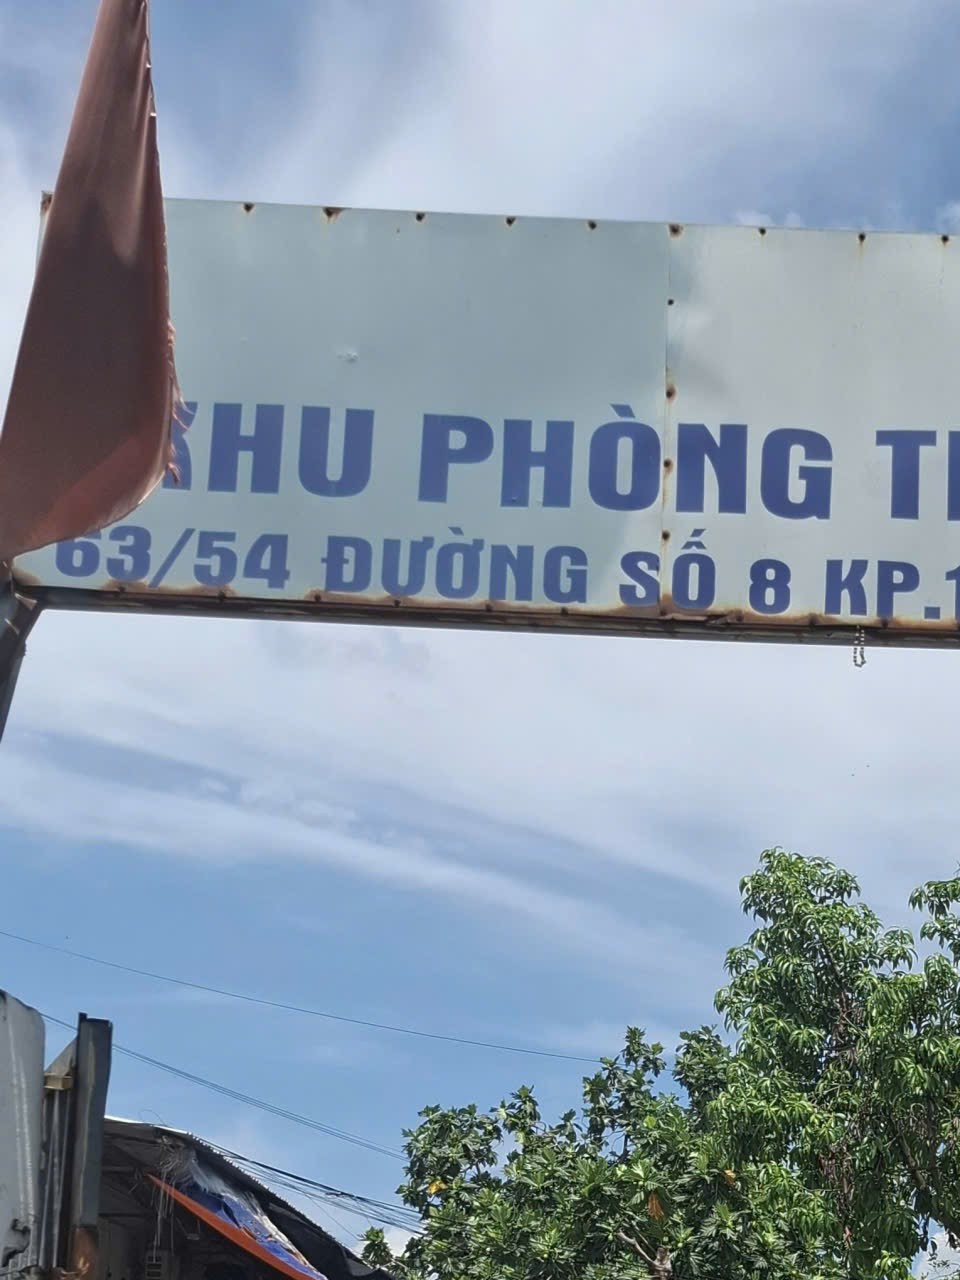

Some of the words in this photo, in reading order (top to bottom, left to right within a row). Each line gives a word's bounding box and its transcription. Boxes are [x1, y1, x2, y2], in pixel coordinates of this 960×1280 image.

[419, 404, 833, 518] PHÒNG
[55, 525, 290, 588] 63/54
[322, 526, 588, 603] ĐƯỜNG
[620, 529, 716, 608] SỐ
[749, 559, 791, 615] 8
